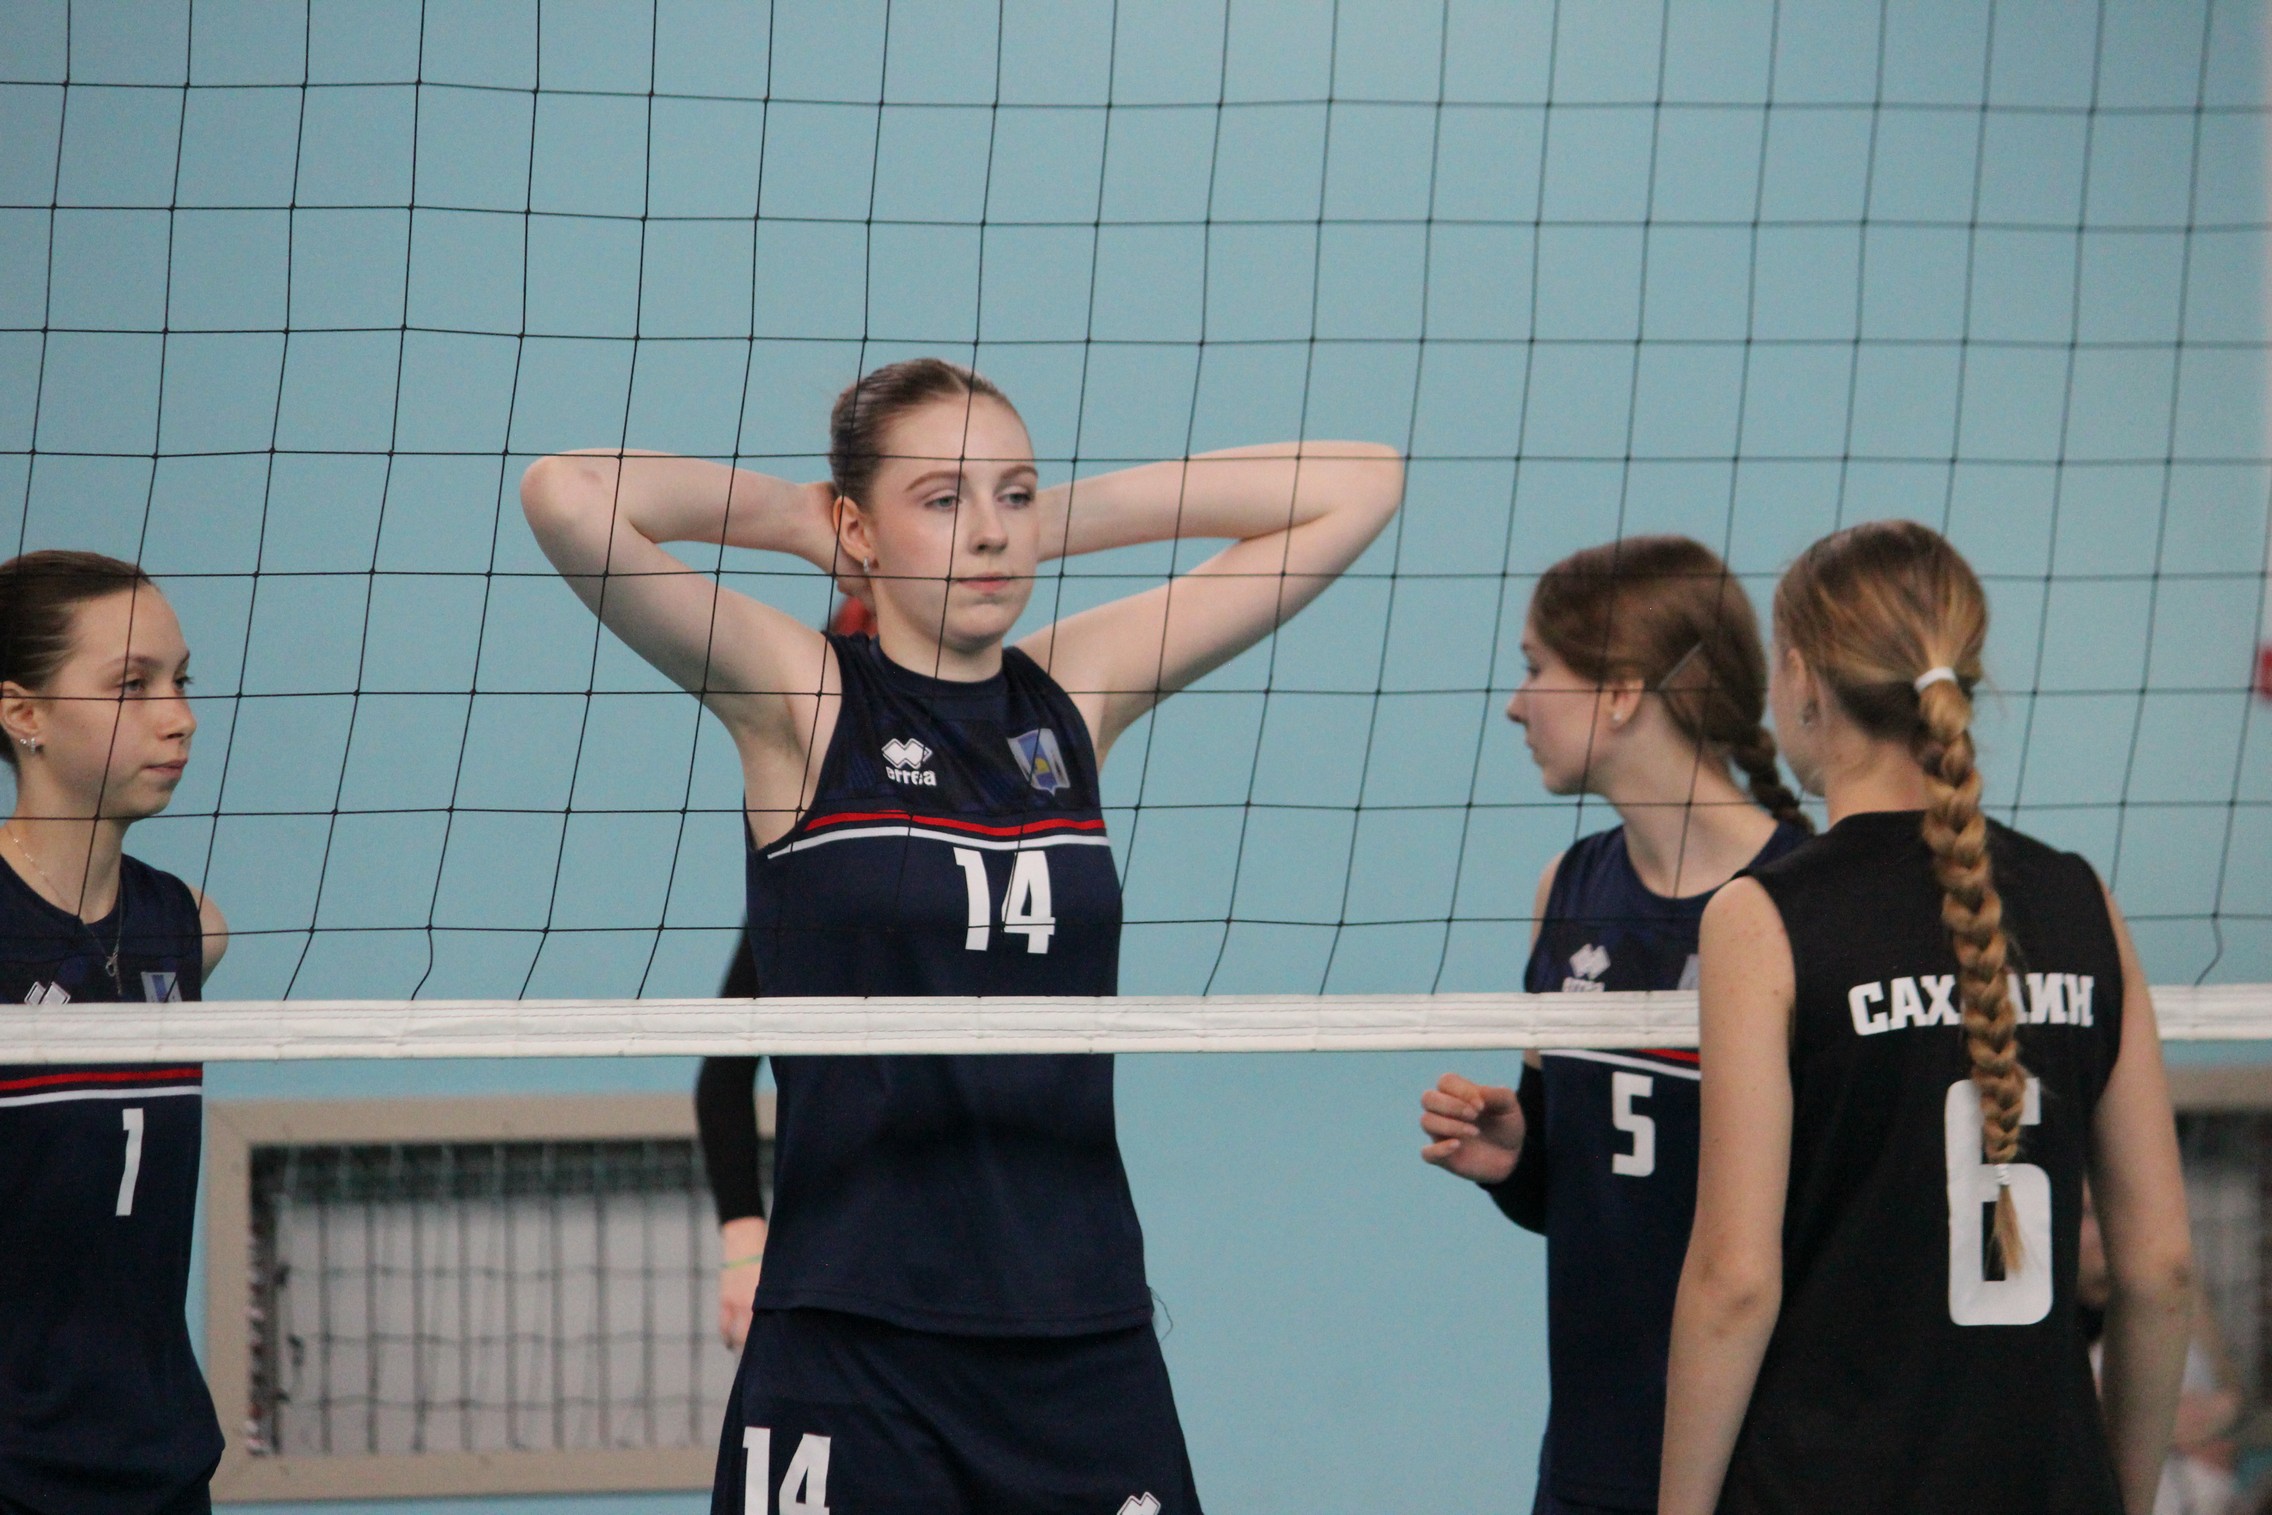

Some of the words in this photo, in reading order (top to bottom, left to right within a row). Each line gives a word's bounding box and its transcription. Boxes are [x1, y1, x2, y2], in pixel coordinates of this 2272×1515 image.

[953, 847, 1056, 954] 14
[1848, 972, 2094, 1036] САХИН
[115, 1108, 144, 1216] 1
[1612, 1071, 1656, 1177] 5
[1944, 1077, 2053, 1326] 6
[742, 1426, 831, 1515] 14
